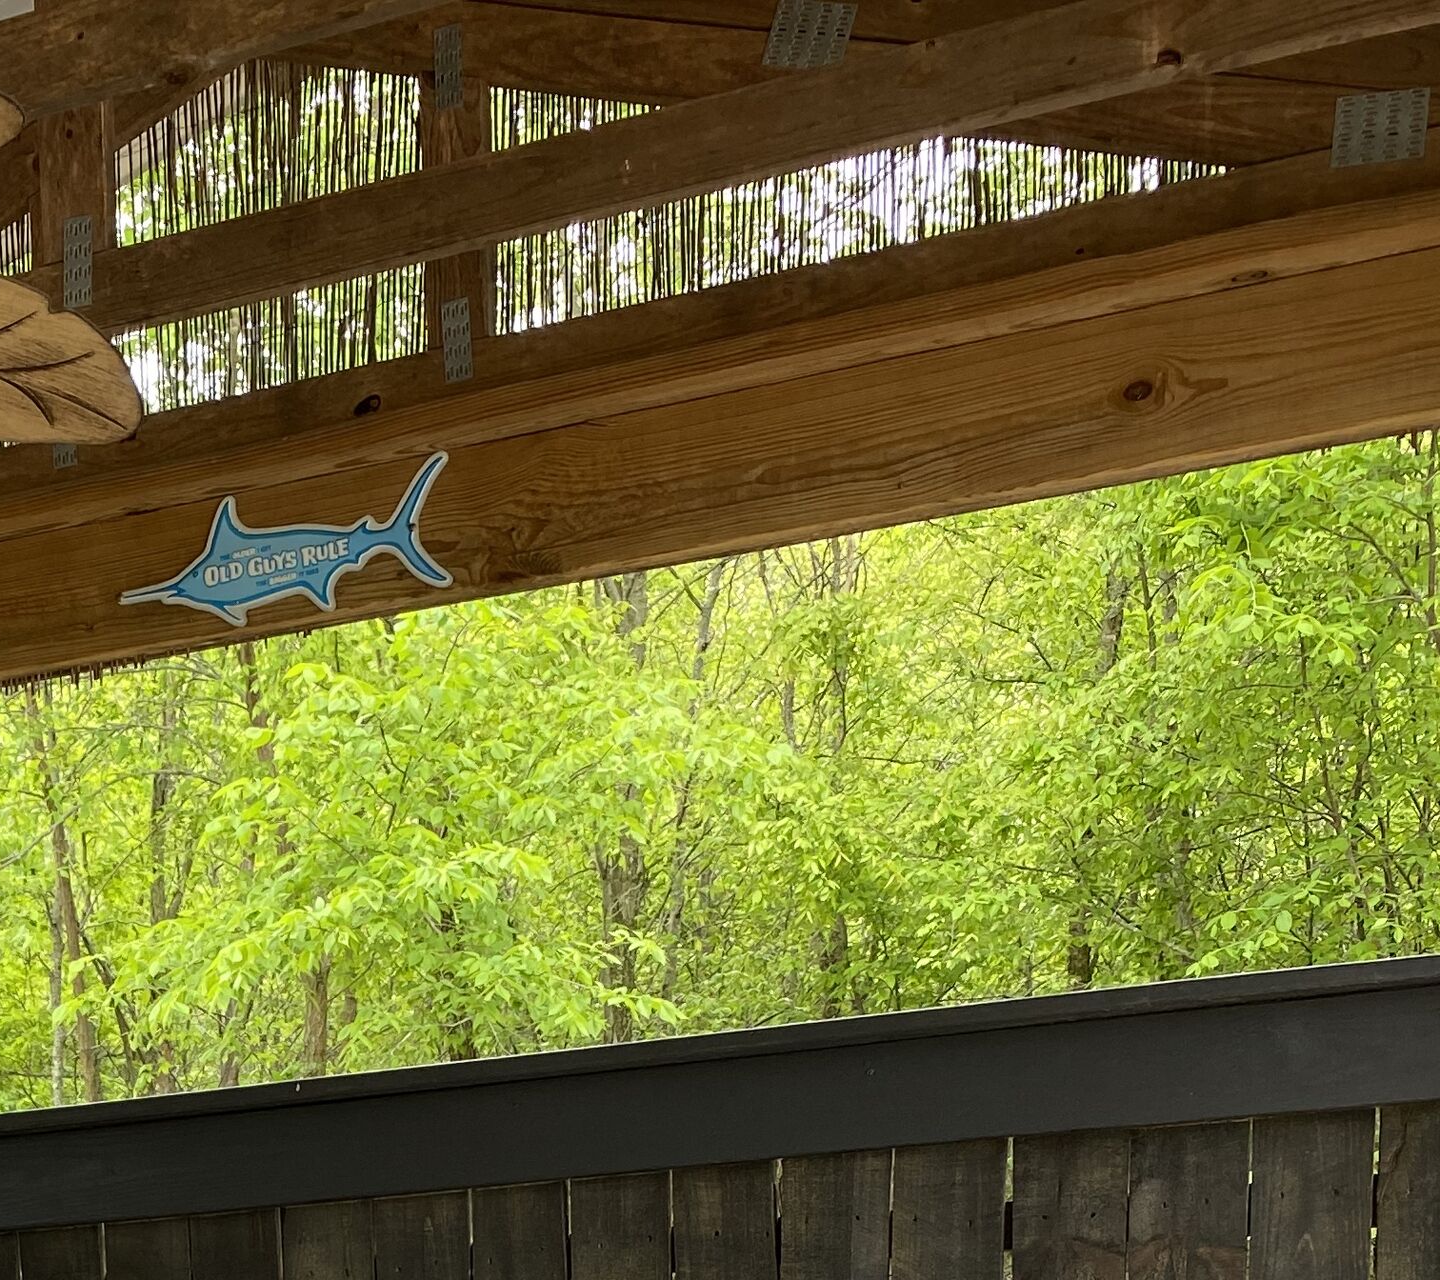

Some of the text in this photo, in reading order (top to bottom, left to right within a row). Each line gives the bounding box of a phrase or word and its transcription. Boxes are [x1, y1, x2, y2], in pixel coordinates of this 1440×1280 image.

[203, 561, 244, 587] OLD
[246, 550, 298, 577] GUYS
[300, 537, 350, 567] RULE
